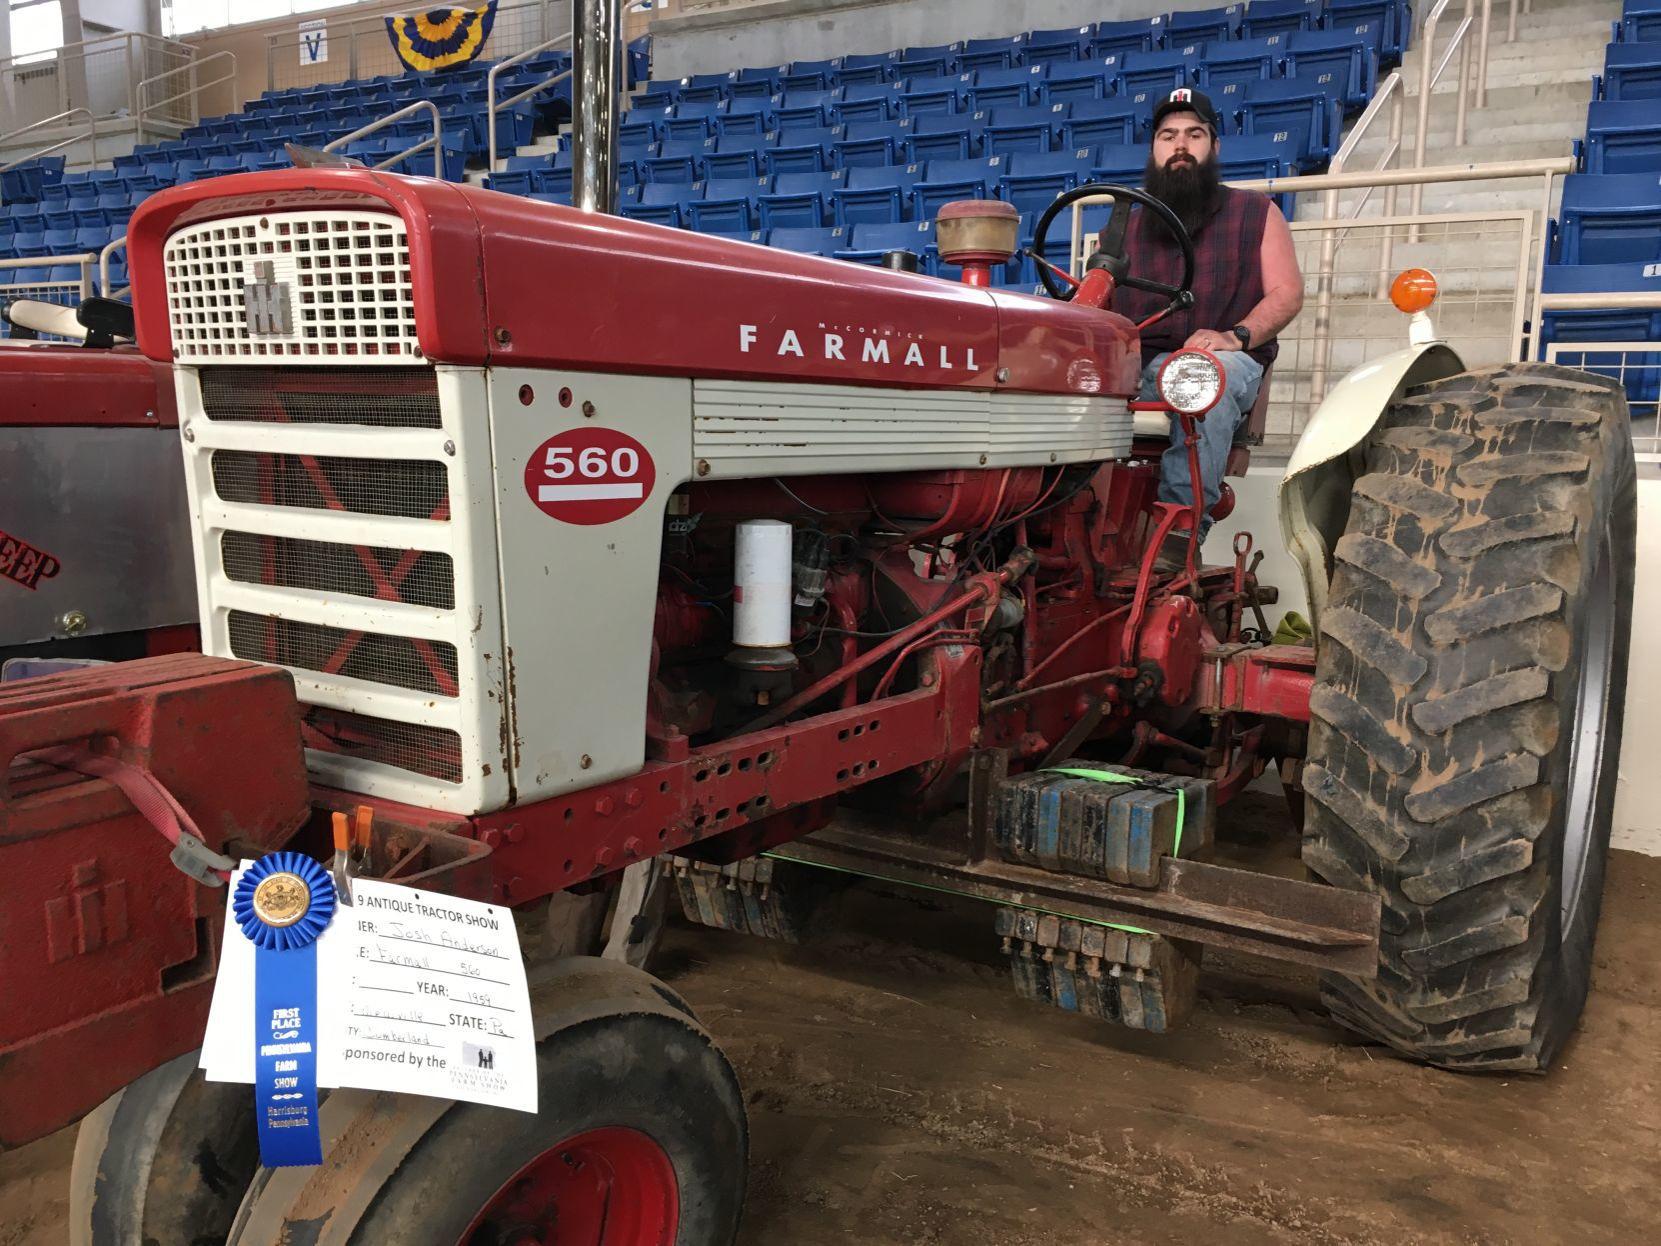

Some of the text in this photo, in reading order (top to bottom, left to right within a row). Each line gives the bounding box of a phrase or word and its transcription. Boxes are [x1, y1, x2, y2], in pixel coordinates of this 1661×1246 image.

[305, 32, 321, 61] V
[739, 324, 979, 371] FARMALL
[543, 447, 639, 479] 560
[367, 896, 413, 914] ANTIQUE
[415, 904, 464, 924] TRACTOR
[465, 914, 499, 930] SHOW
[460, 962, 481, 976] 560
[416, 981, 449, 997] YEAR:
[273, 1008, 300, 1019] FIRST
[271, 1018, 302, 1030] PLACE
[449, 1013, 487, 1031] STATE:
[275, 1060, 298, 1072] FARM
[345, 1048, 447, 1070] ponsored by the
[274, 1077, 298, 1089] SHOW
[267, 1106, 308, 1117] Harrisburg
[268, 1117, 310, 1129] Pennsylvania
